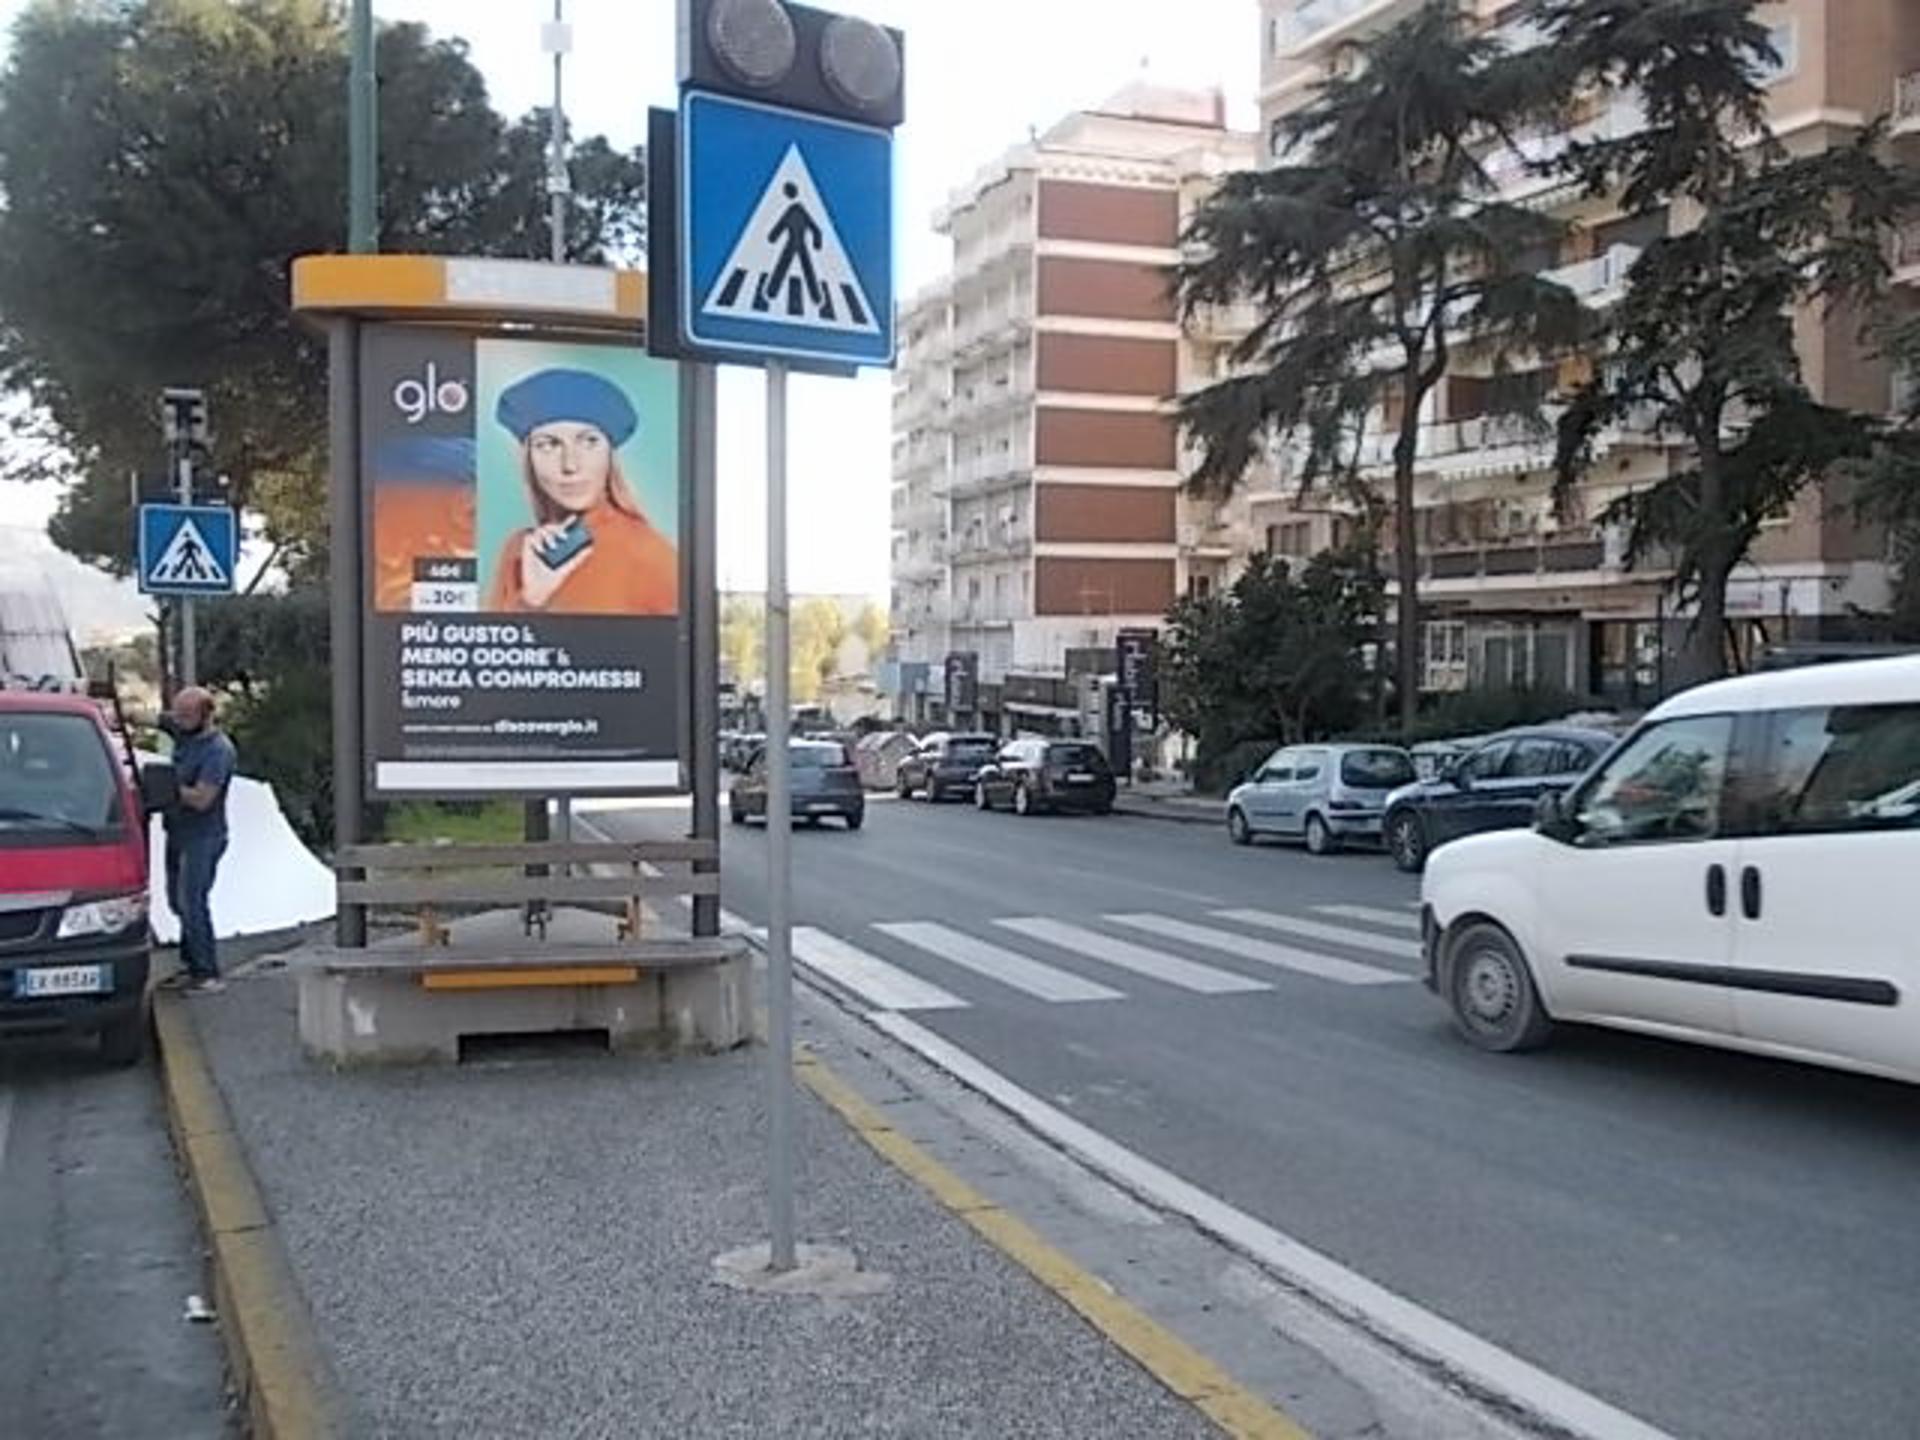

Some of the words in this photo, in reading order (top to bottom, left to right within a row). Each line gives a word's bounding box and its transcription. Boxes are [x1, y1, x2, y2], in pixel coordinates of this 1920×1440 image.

[394, 362, 468, 423] glo
[401, 619, 439, 643] PIÙ
[442, 624, 520, 644] GUSTO
[401, 646, 469, 666] MENO
[401, 668, 474, 689] SENZA
[476, 669, 642, 689] COMPROMESSI
